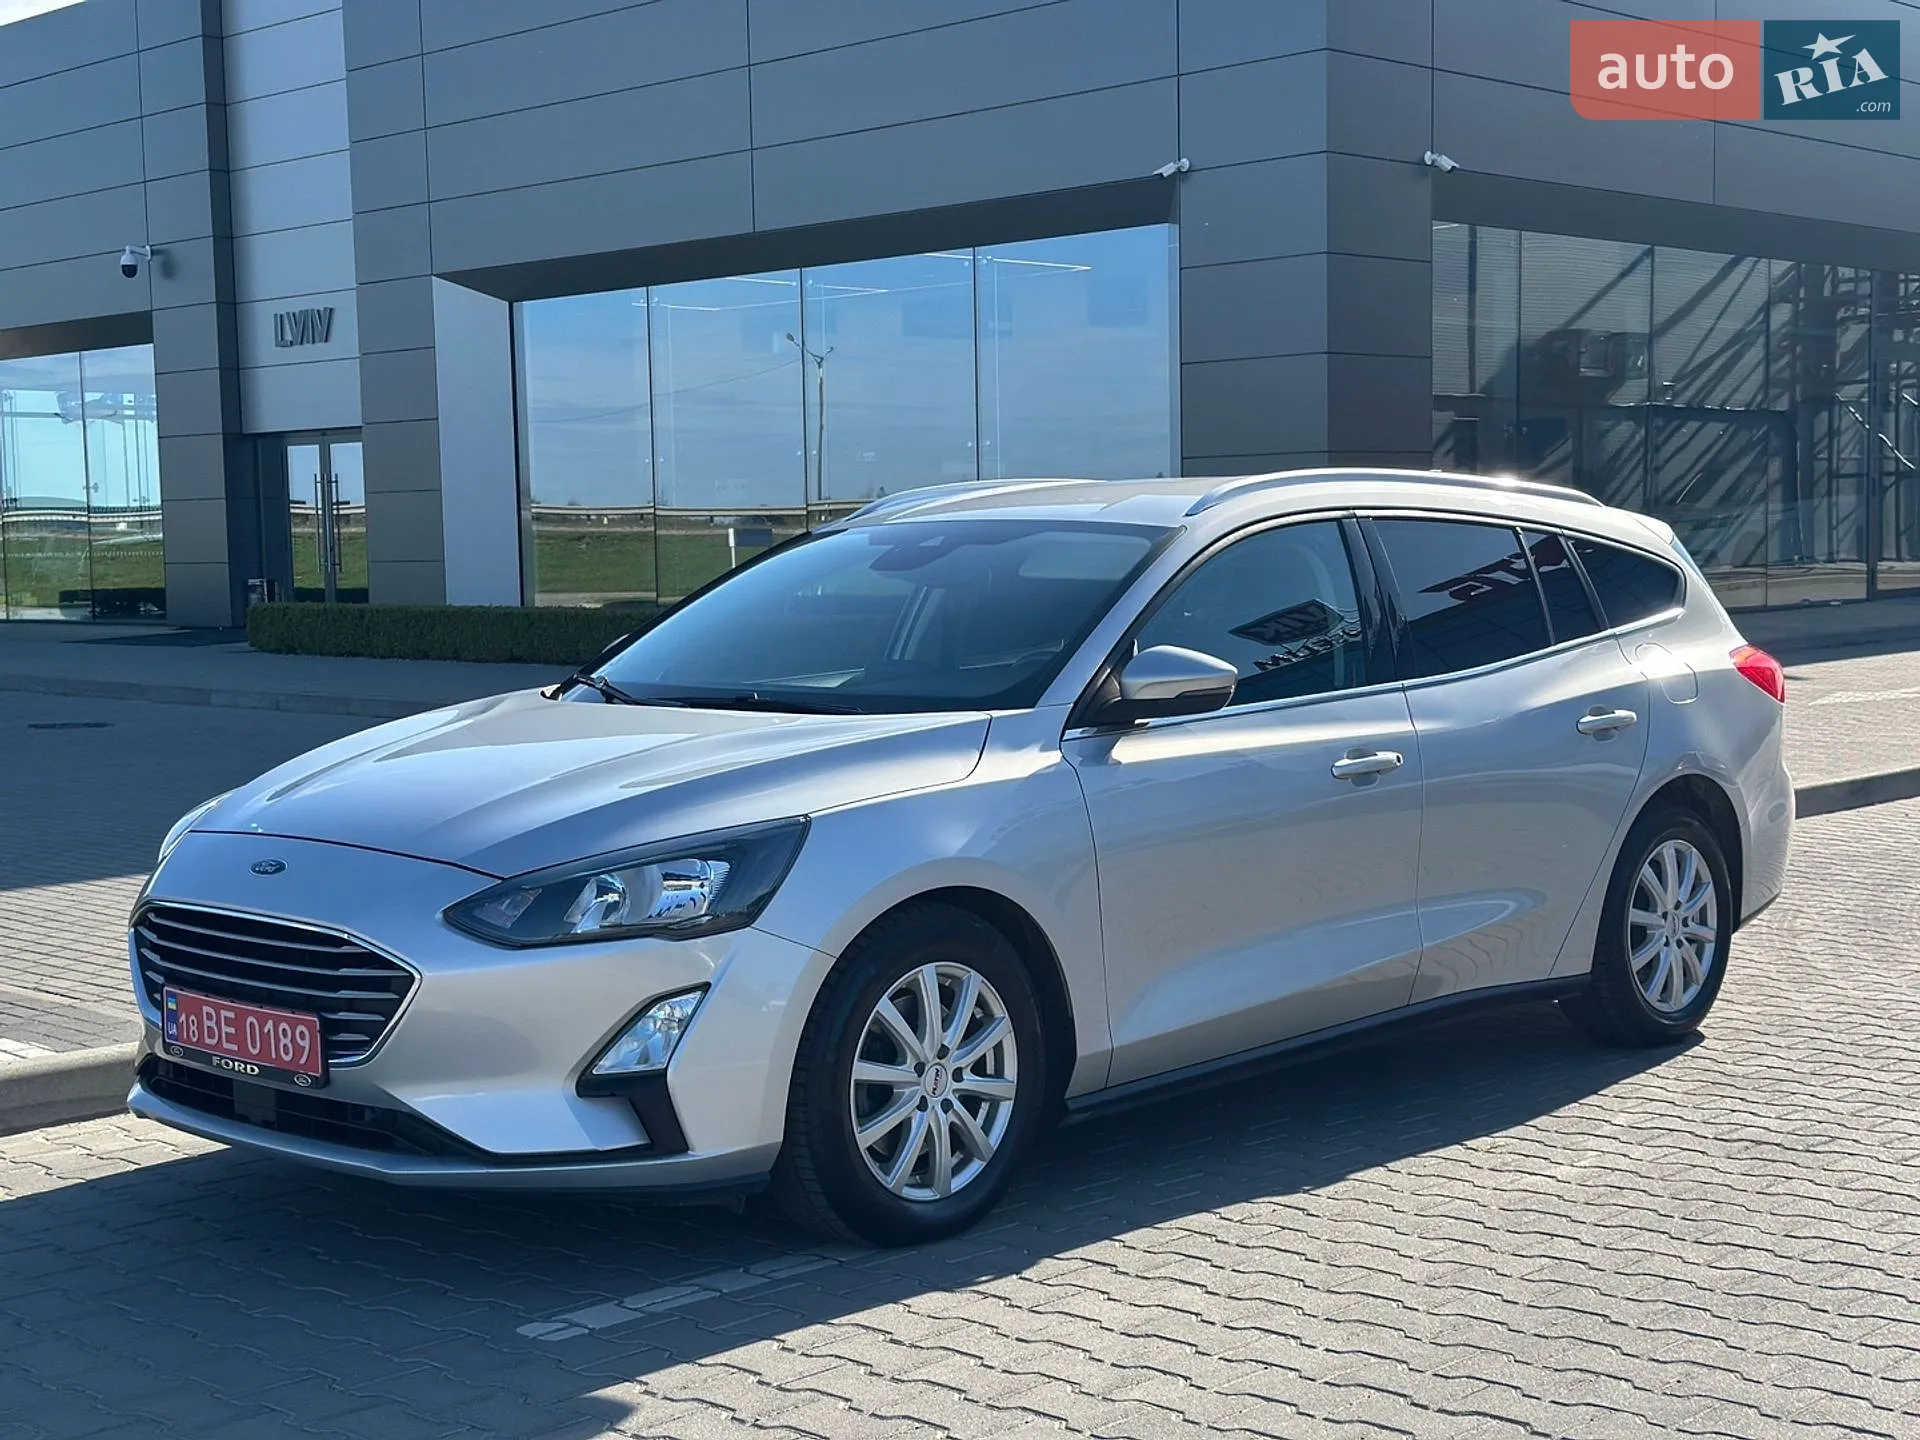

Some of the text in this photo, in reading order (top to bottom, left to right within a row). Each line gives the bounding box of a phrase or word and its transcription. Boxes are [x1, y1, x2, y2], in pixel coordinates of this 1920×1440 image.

[273, 306, 334, 347] LVIV
[168, 1021, 177, 1035] UA
[178, 1006, 311, 1065] 18 BE 0189
[212, 1056, 260, 1075] FORD
